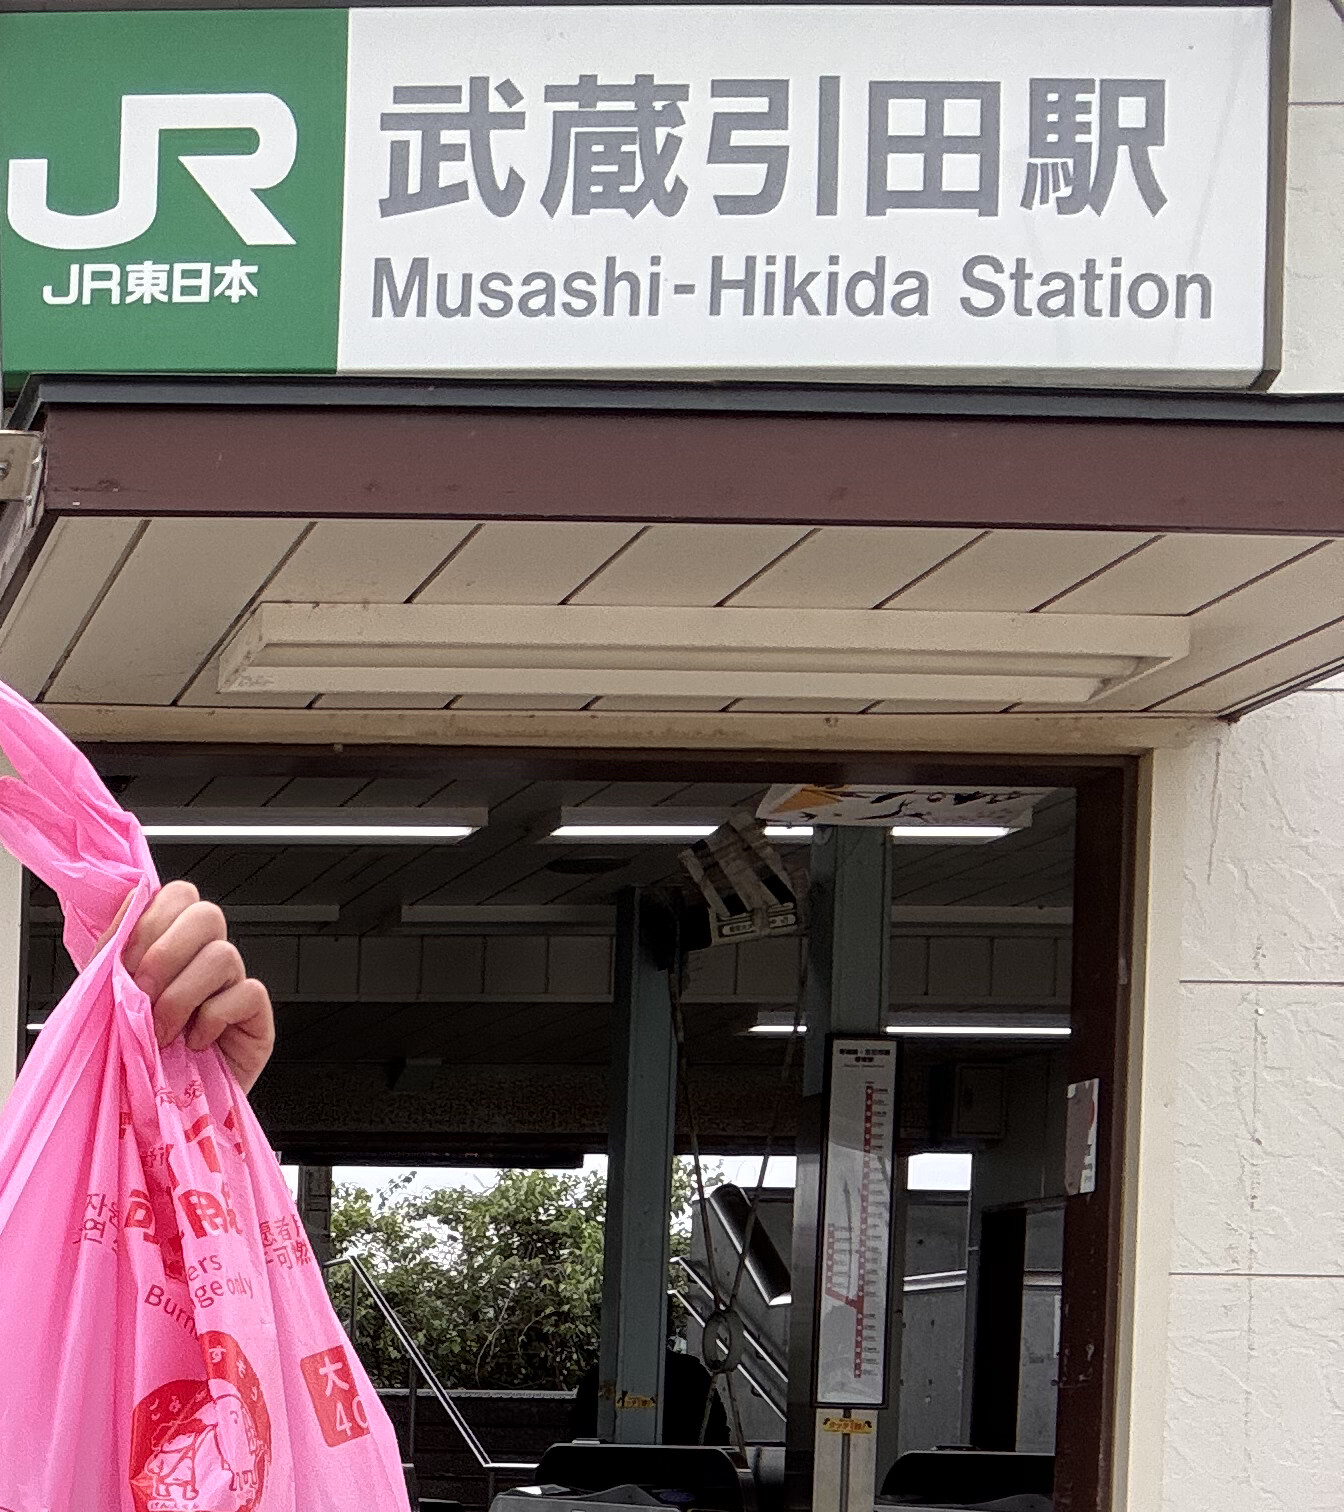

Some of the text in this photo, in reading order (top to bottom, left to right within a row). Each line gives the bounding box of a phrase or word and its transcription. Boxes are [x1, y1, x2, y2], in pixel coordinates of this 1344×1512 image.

[6, 91, 299, 252] JR
[375, 72, 1169, 219] 武蔵引田駅
[42, 261, 261, 305] JR東日本
[372, 253, 1214, 321] Musashi-Hikida Station
[318, 1355, 350, 1398] 大
